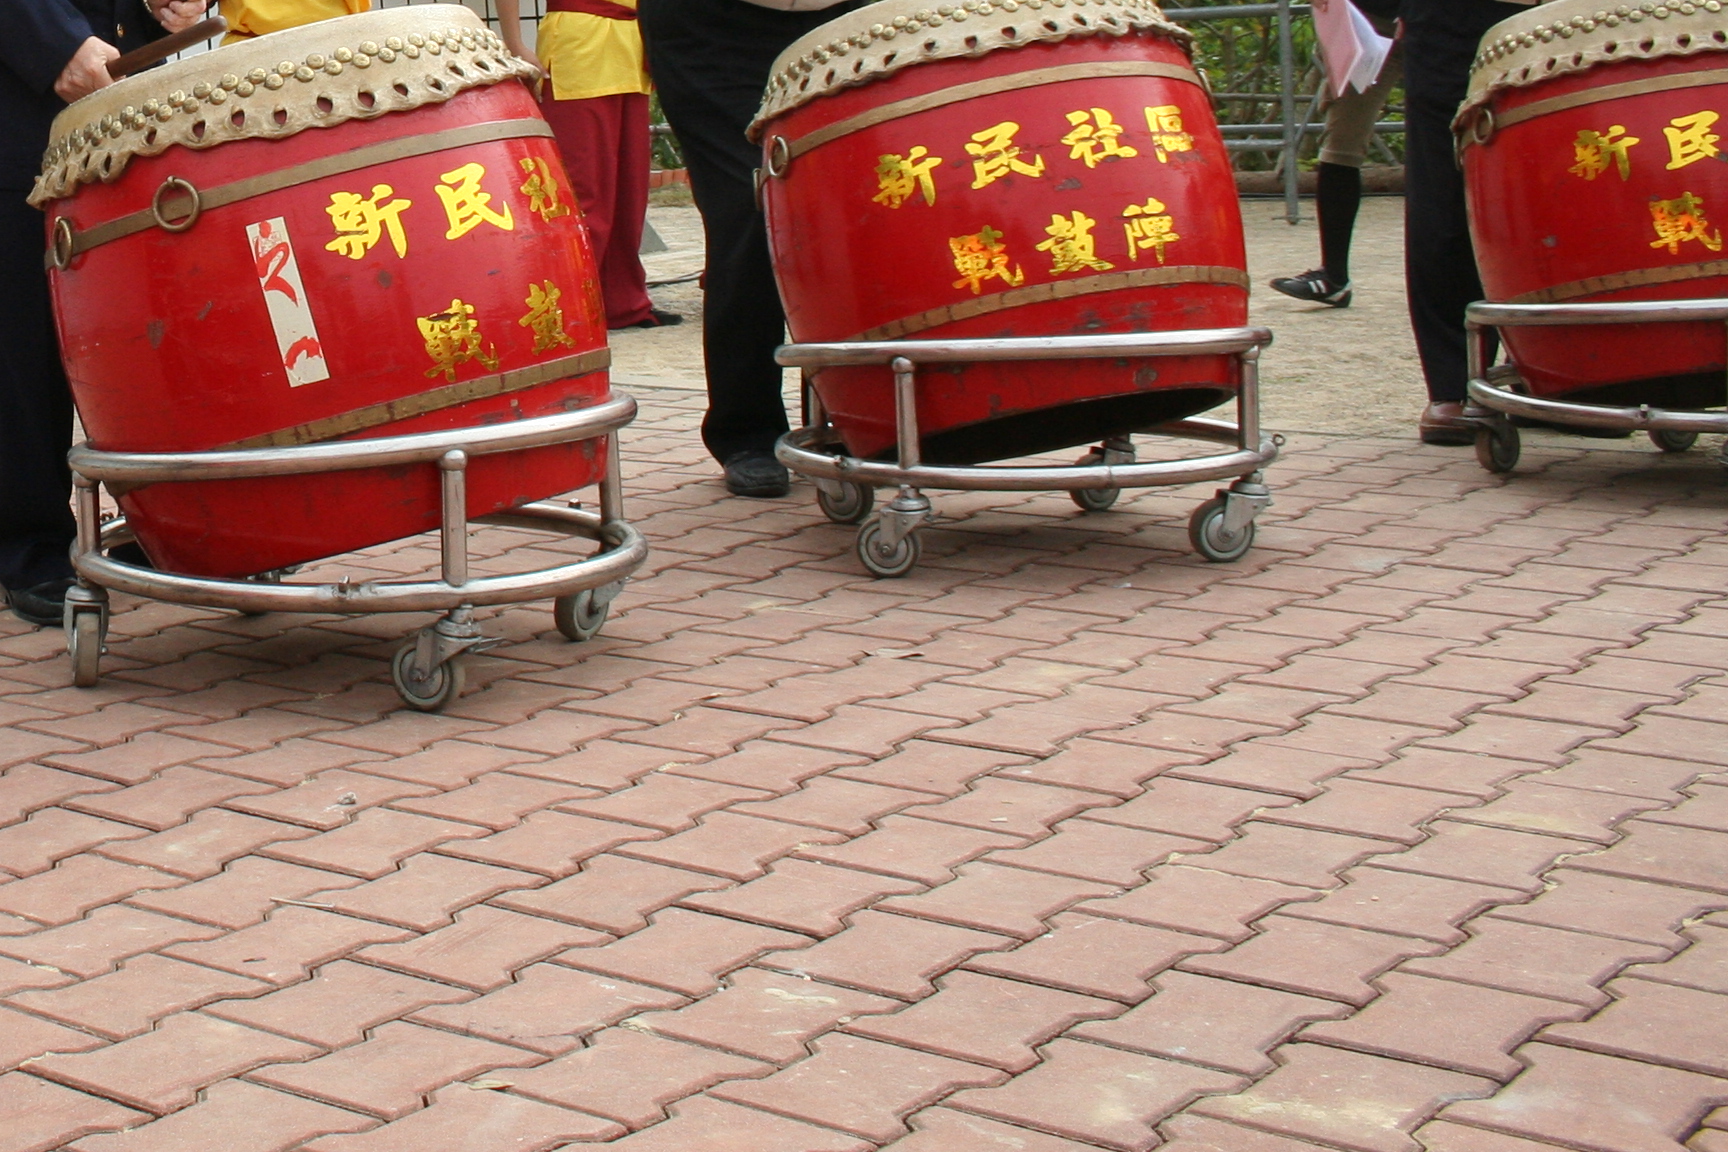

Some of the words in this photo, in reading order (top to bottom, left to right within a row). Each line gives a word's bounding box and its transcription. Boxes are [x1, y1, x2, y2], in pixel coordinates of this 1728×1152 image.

[872, 104, 1195, 210] 新民社區
[1567, 110, 1720, 182] 新民
[325, 156, 571, 260] 新民社
[948, 197, 1180, 295] 戰鼓陣
[416, 278, 604, 383] 戰鼓
